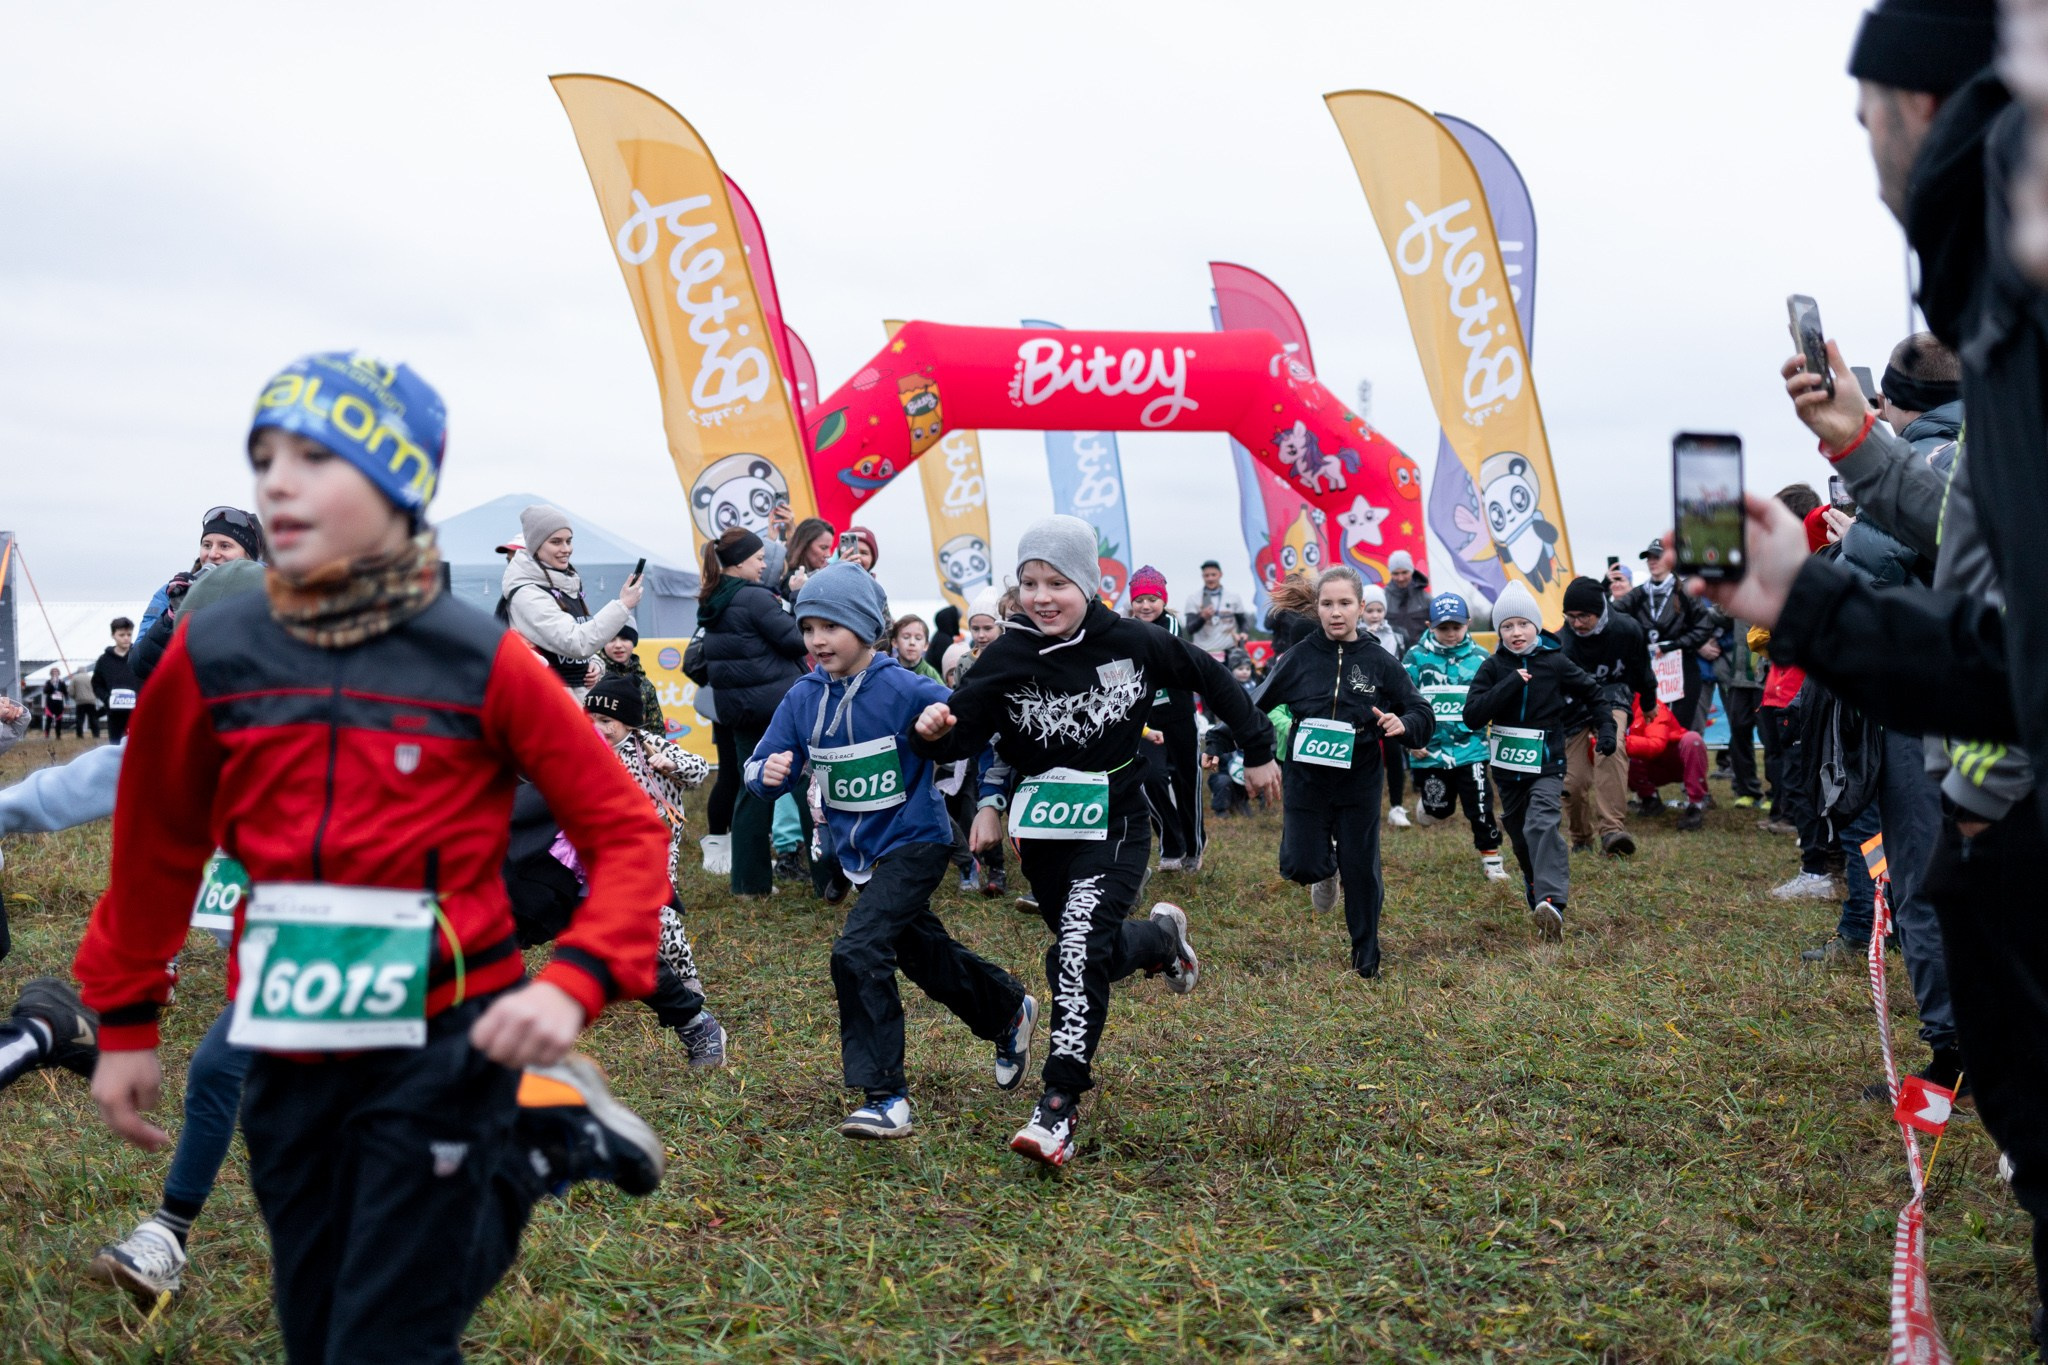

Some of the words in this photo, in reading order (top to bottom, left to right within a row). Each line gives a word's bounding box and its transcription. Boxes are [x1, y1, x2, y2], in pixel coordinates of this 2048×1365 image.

[1018, 338, 1199, 427] Bitey
[1353, 683, 1376, 693] FILA
[1305, 739, 1350, 759] 6012
[1500, 746, 1538, 764] 6159
[815, 763, 833, 773] KIDS
[834, 769, 897, 798] 6018
[1020, 785, 1039, 794] KIDS
[1030, 801, 1104, 825] 6010
[262, 960, 417, 1016] 6015
